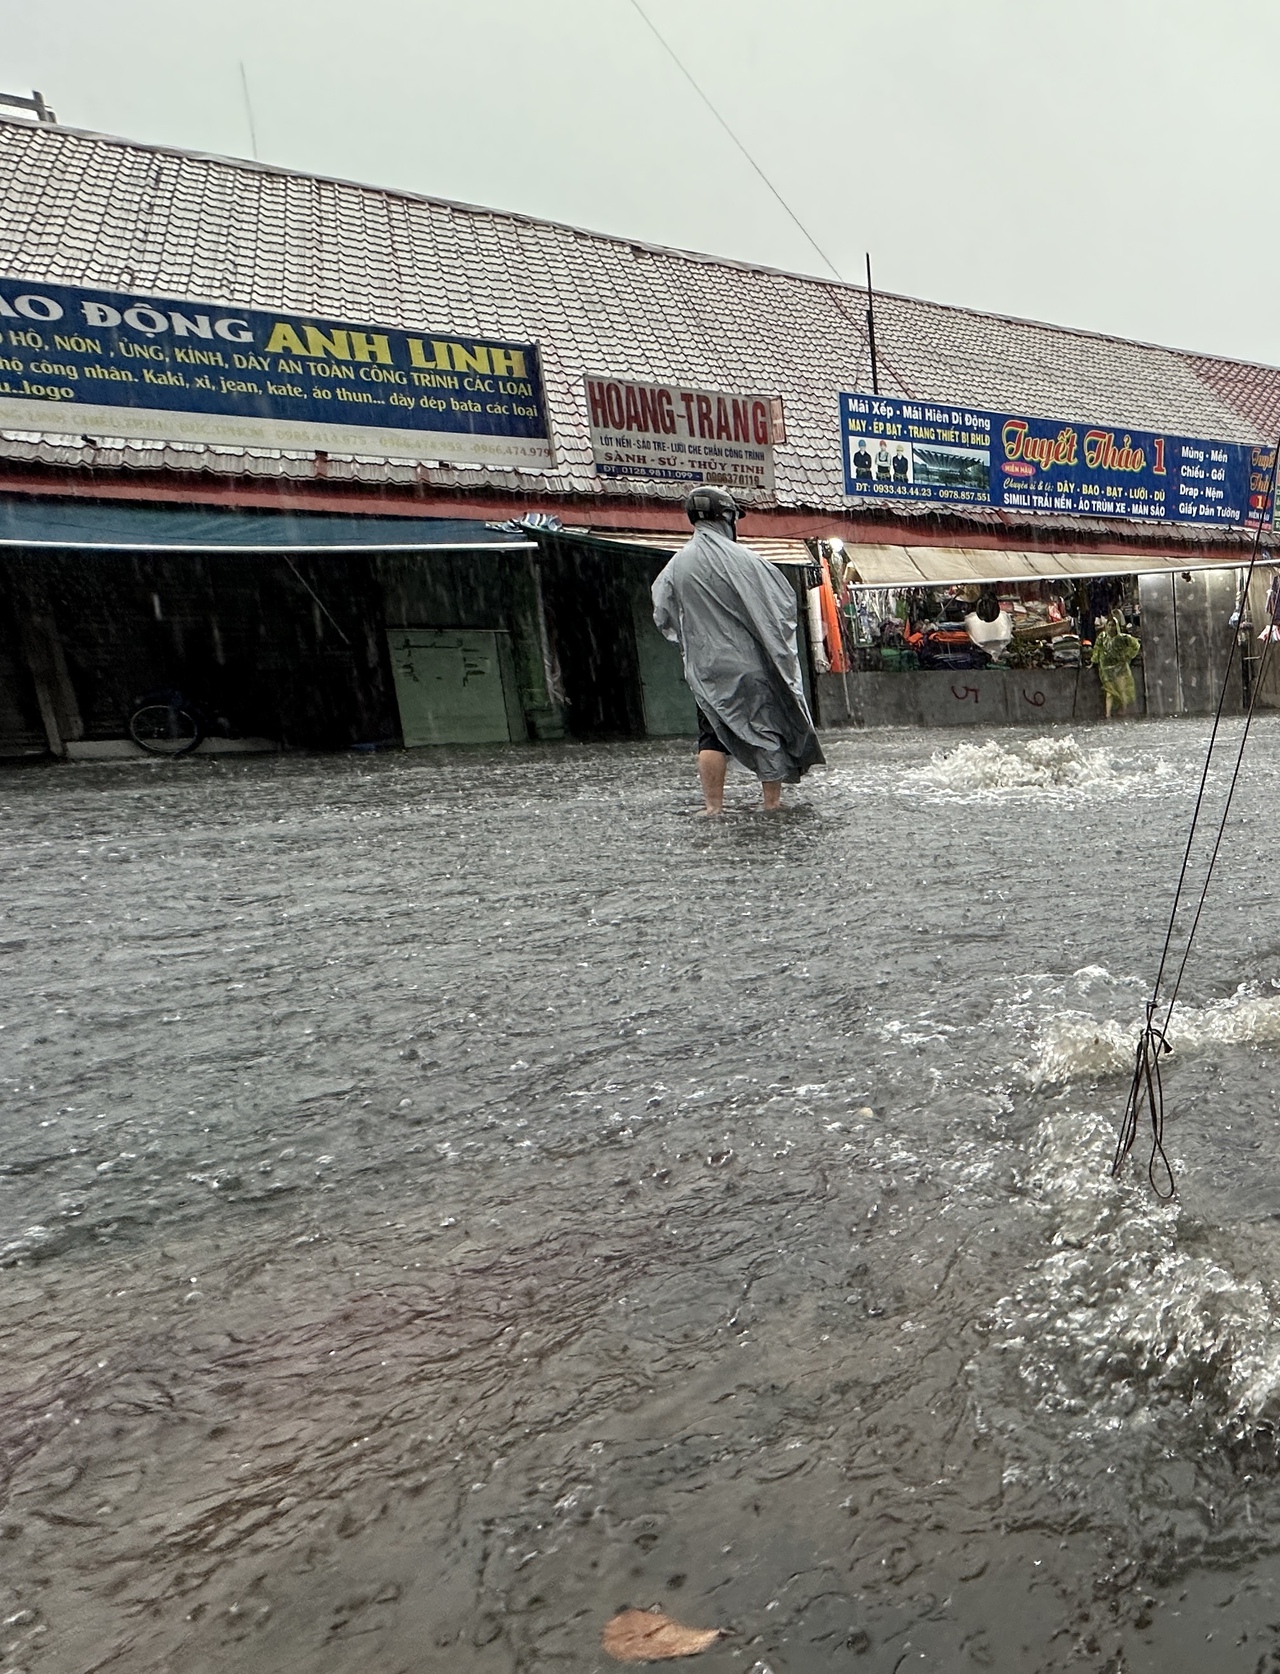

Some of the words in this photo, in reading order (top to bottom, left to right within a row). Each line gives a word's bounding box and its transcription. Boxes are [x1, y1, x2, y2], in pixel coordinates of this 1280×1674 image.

[81, 301, 254, 343] ĐỘNG
[264, 322, 394, 366] ANH
[406, 338, 529, 379] LINH
[233, 351, 271, 372] DÂY
[278, 360, 303, 375] AN
[306, 360, 355, 380] TOÀN
[360, 364, 407, 385] CÔNG
[411, 370, 460, 390] TRÌNH
[463, 374, 496, 393] CÁC
[498, 380, 533, 399] LOẠI
[30, 360, 79, 380] công
[84, 363, 139, 383] nhân.
[142, 368, 190, 389] Kaki,
[220, 376, 262, 396] jean,
[267, 381, 307, 399] kate,
[312, 385, 332, 400] áo
[420, 395, 447, 412] dép
[451, 397, 482, 414] bata
[486, 402, 510, 416] các
[513, 403, 538, 420] loại
[848, 399, 869, 414] Mái
[871, 400, 894, 419] Xếp
[902, 405, 922, 421] Mái
[924, 407, 949, 424] Hiên
[951, 411, 962, 426] Di
[964, 413, 991, 431] Động
[848, 418, 867, 433] MAY
[873, 418, 885, 435] ÉP
[885, 422, 902, 439] BẠT
[908, 425, 936, 441] TRANG
[936, 425, 960, 443] THIẾT
[653, 440, 667, 452] TRE
[688, 444, 703, 456] CHE
[725, 447, 744, 460] CÔNG
[1002, 419, 1079, 471] Tuyết
[1084, 429, 1147, 473] Thảo
[1153, 438, 1167, 475] 1
[1181, 445, 1205, 463] Mùng
[604, 450, 647, 465] SÀNH
[688, 459, 727, 471] THỦY
[731, 463, 765, 475] TINH
[1180, 464, 1205, 479] Chiếu
[1211, 468, 1226, 481] Gối
[856, 482, 871, 493] ĐT:
[1057, 480, 1075, 494] DÂY
[1082, 484, 1100, 496] BAO
[1106, 486, 1123, 500] BẠT
[1154, 488, 1166, 502] DÙ
[1179, 484, 1199, 499] Drap
[1205, 486, 1224, 501] Nệm
[1003, 492, 1031, 506] SIMILI
[1078, 497, 1090, 511] ÁO
[1091, 498, 1114, 513] TRÙM
[1115, 502, 1126, 514] XE
[1131, 501, 1149, 516] MÀN
[1149, 503, 1166, 517] SÁO
[1178, 502, 1198, 518] Giấy
[1198, 504, 1215, 517] Dán
[1216, 504, 1241, 520] Tường
